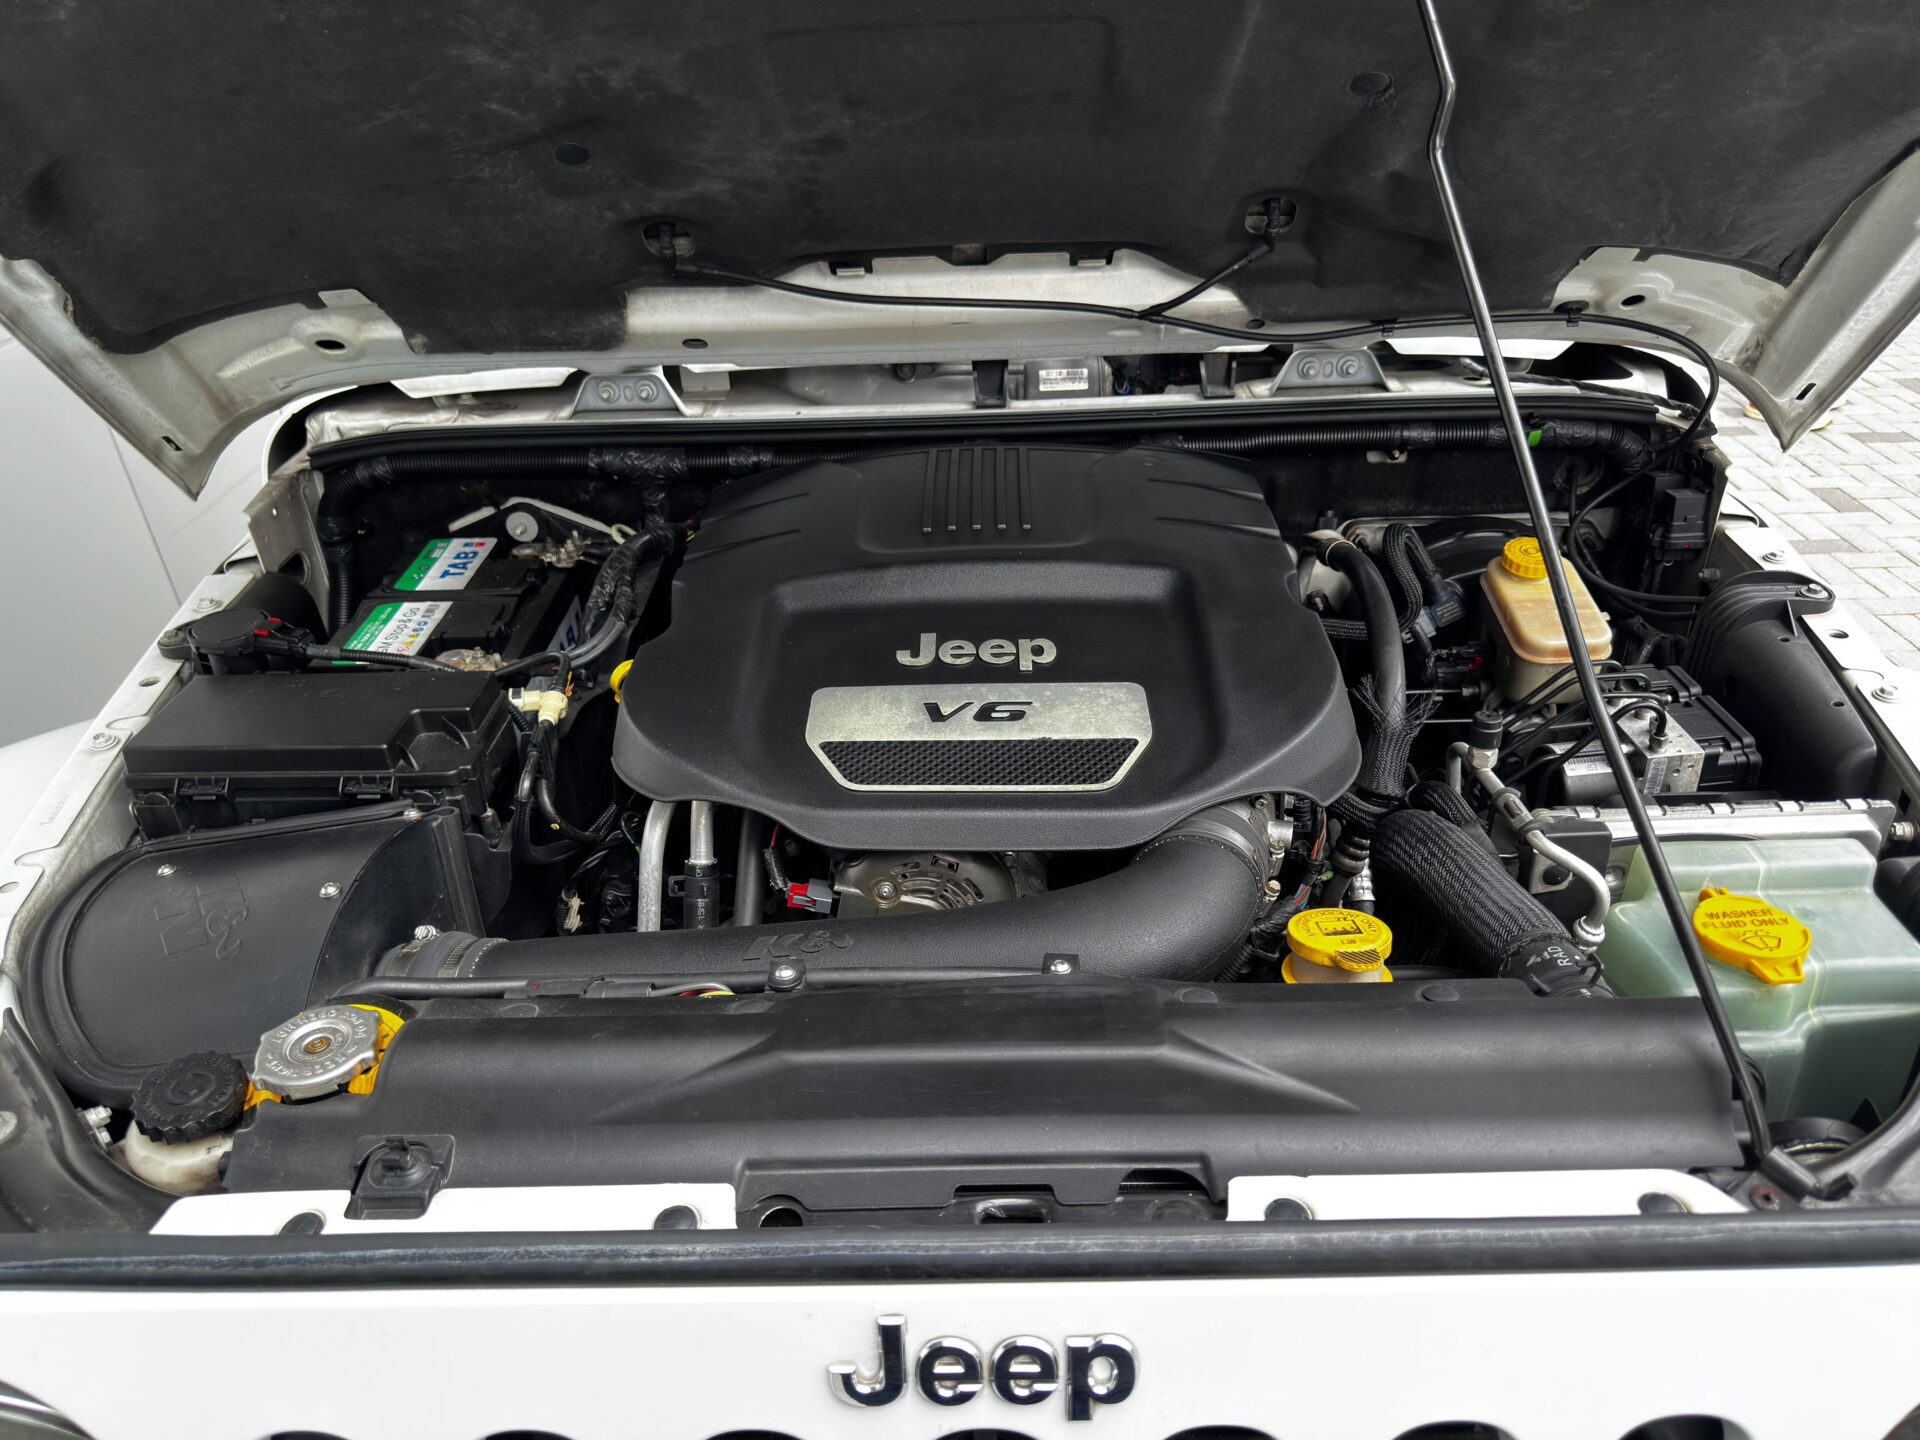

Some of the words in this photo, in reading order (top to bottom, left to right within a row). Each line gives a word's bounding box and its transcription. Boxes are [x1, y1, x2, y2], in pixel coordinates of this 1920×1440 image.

[440, 550, 479, 579] TAB
[399, 614, 413, 624] &
[403, 607, 420, 622] Go
[385, 622, 408, 645] Stop
[896, 633, 1057, 672] Jeep
[923, 701, 1033, 722] V6
[1702, 920, 1747, 929] FLUID
[1751, 917, 1789, 927] ONLY
[1705, 909, 1773, 919] WASHER
[1361, 918, 1379, 934] ONLY
[1547, 946, 1573, 967] RAD
[827, 1313, 1140, 1421] Jeep
